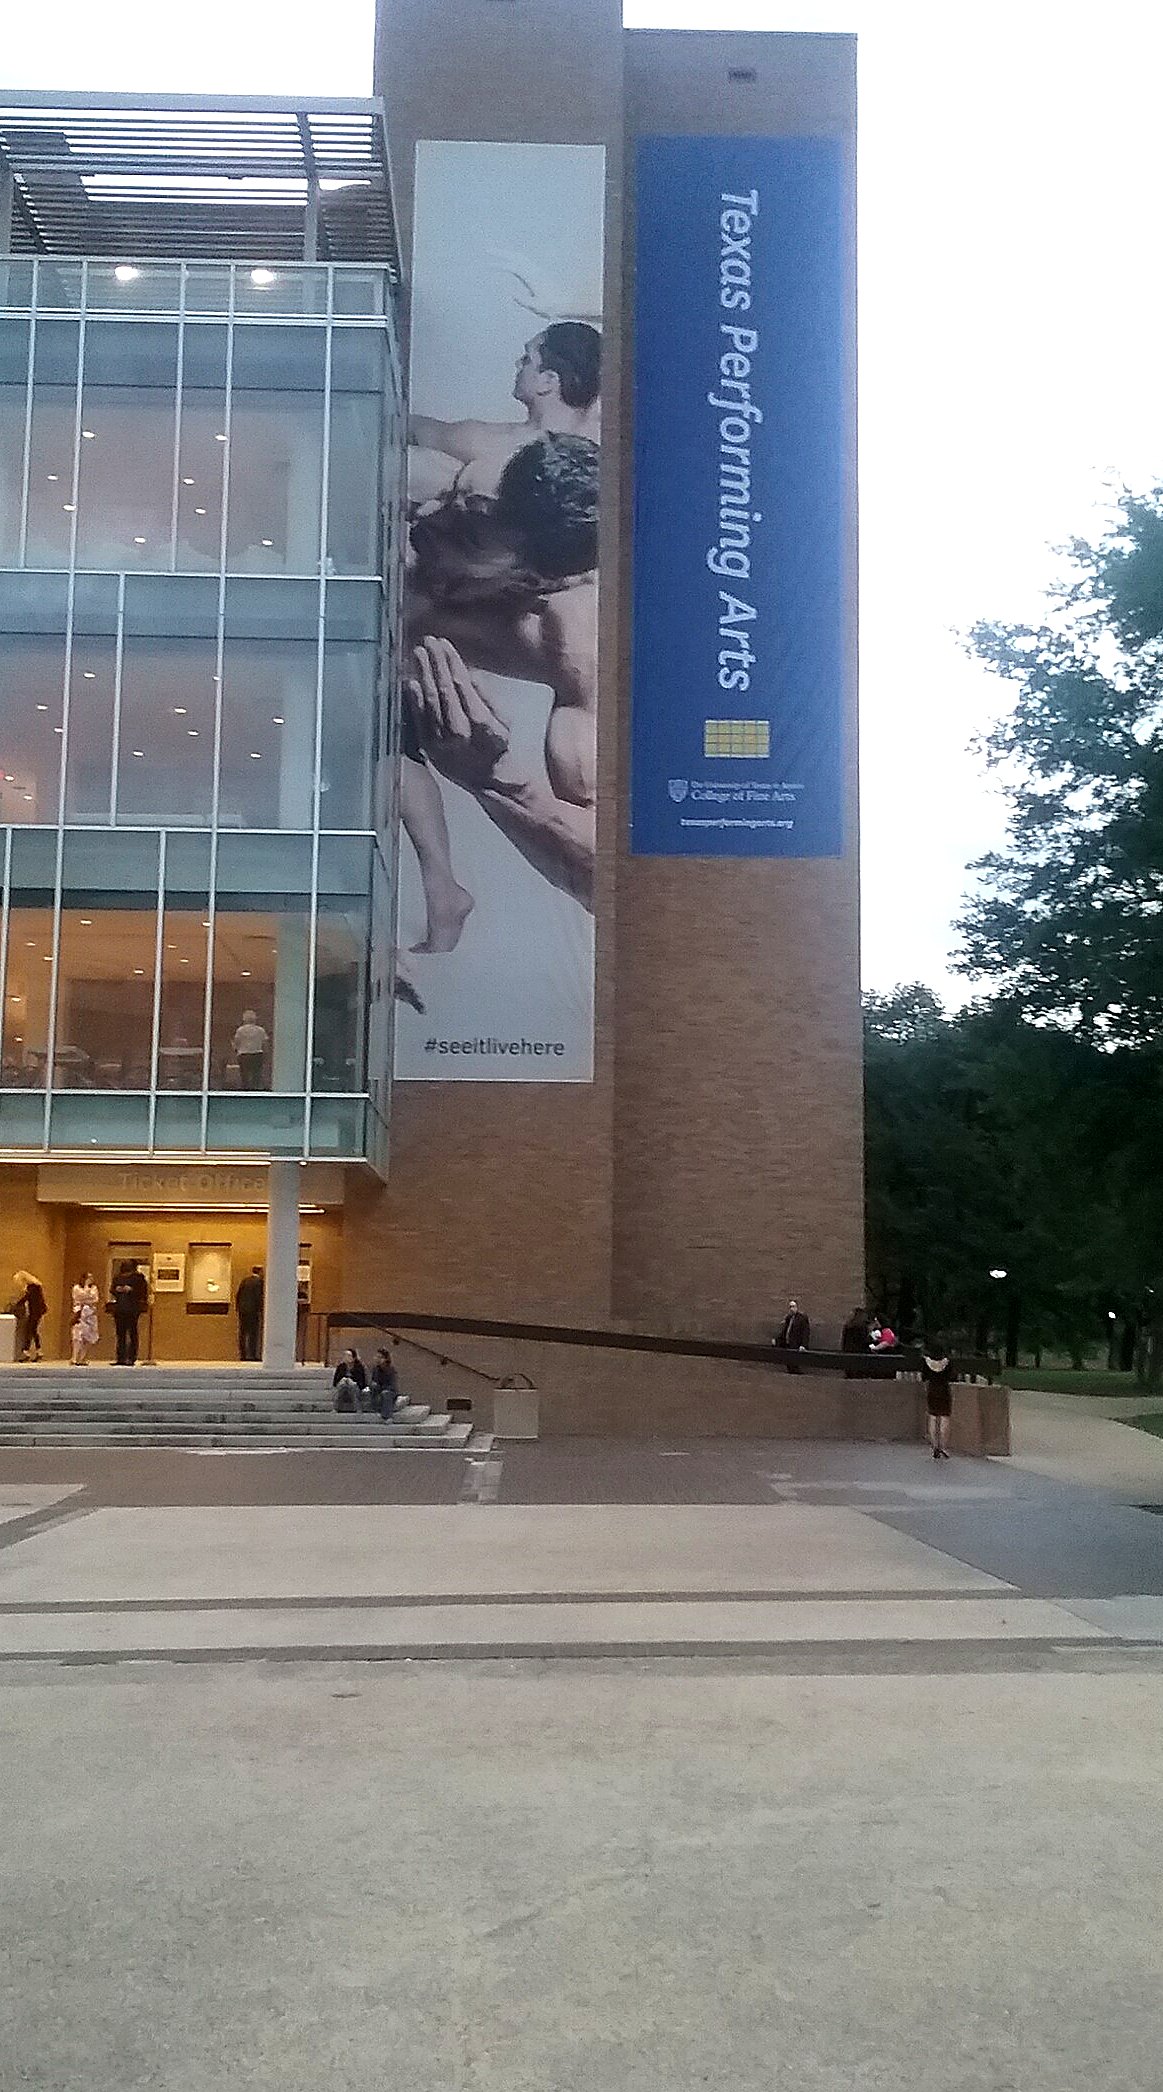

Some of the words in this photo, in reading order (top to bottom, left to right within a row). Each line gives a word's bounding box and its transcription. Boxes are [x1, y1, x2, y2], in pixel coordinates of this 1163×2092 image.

[720, 189, 759, 311] Texas
[706, 324, 764, 579] Performing
[718, 590, 758, 692] Arts
[424, 1037, 566, 1056] #seeitlivehere
[118, 1172, 189, 1192] Ticket
[197, 1172, 266, 1192] Office
